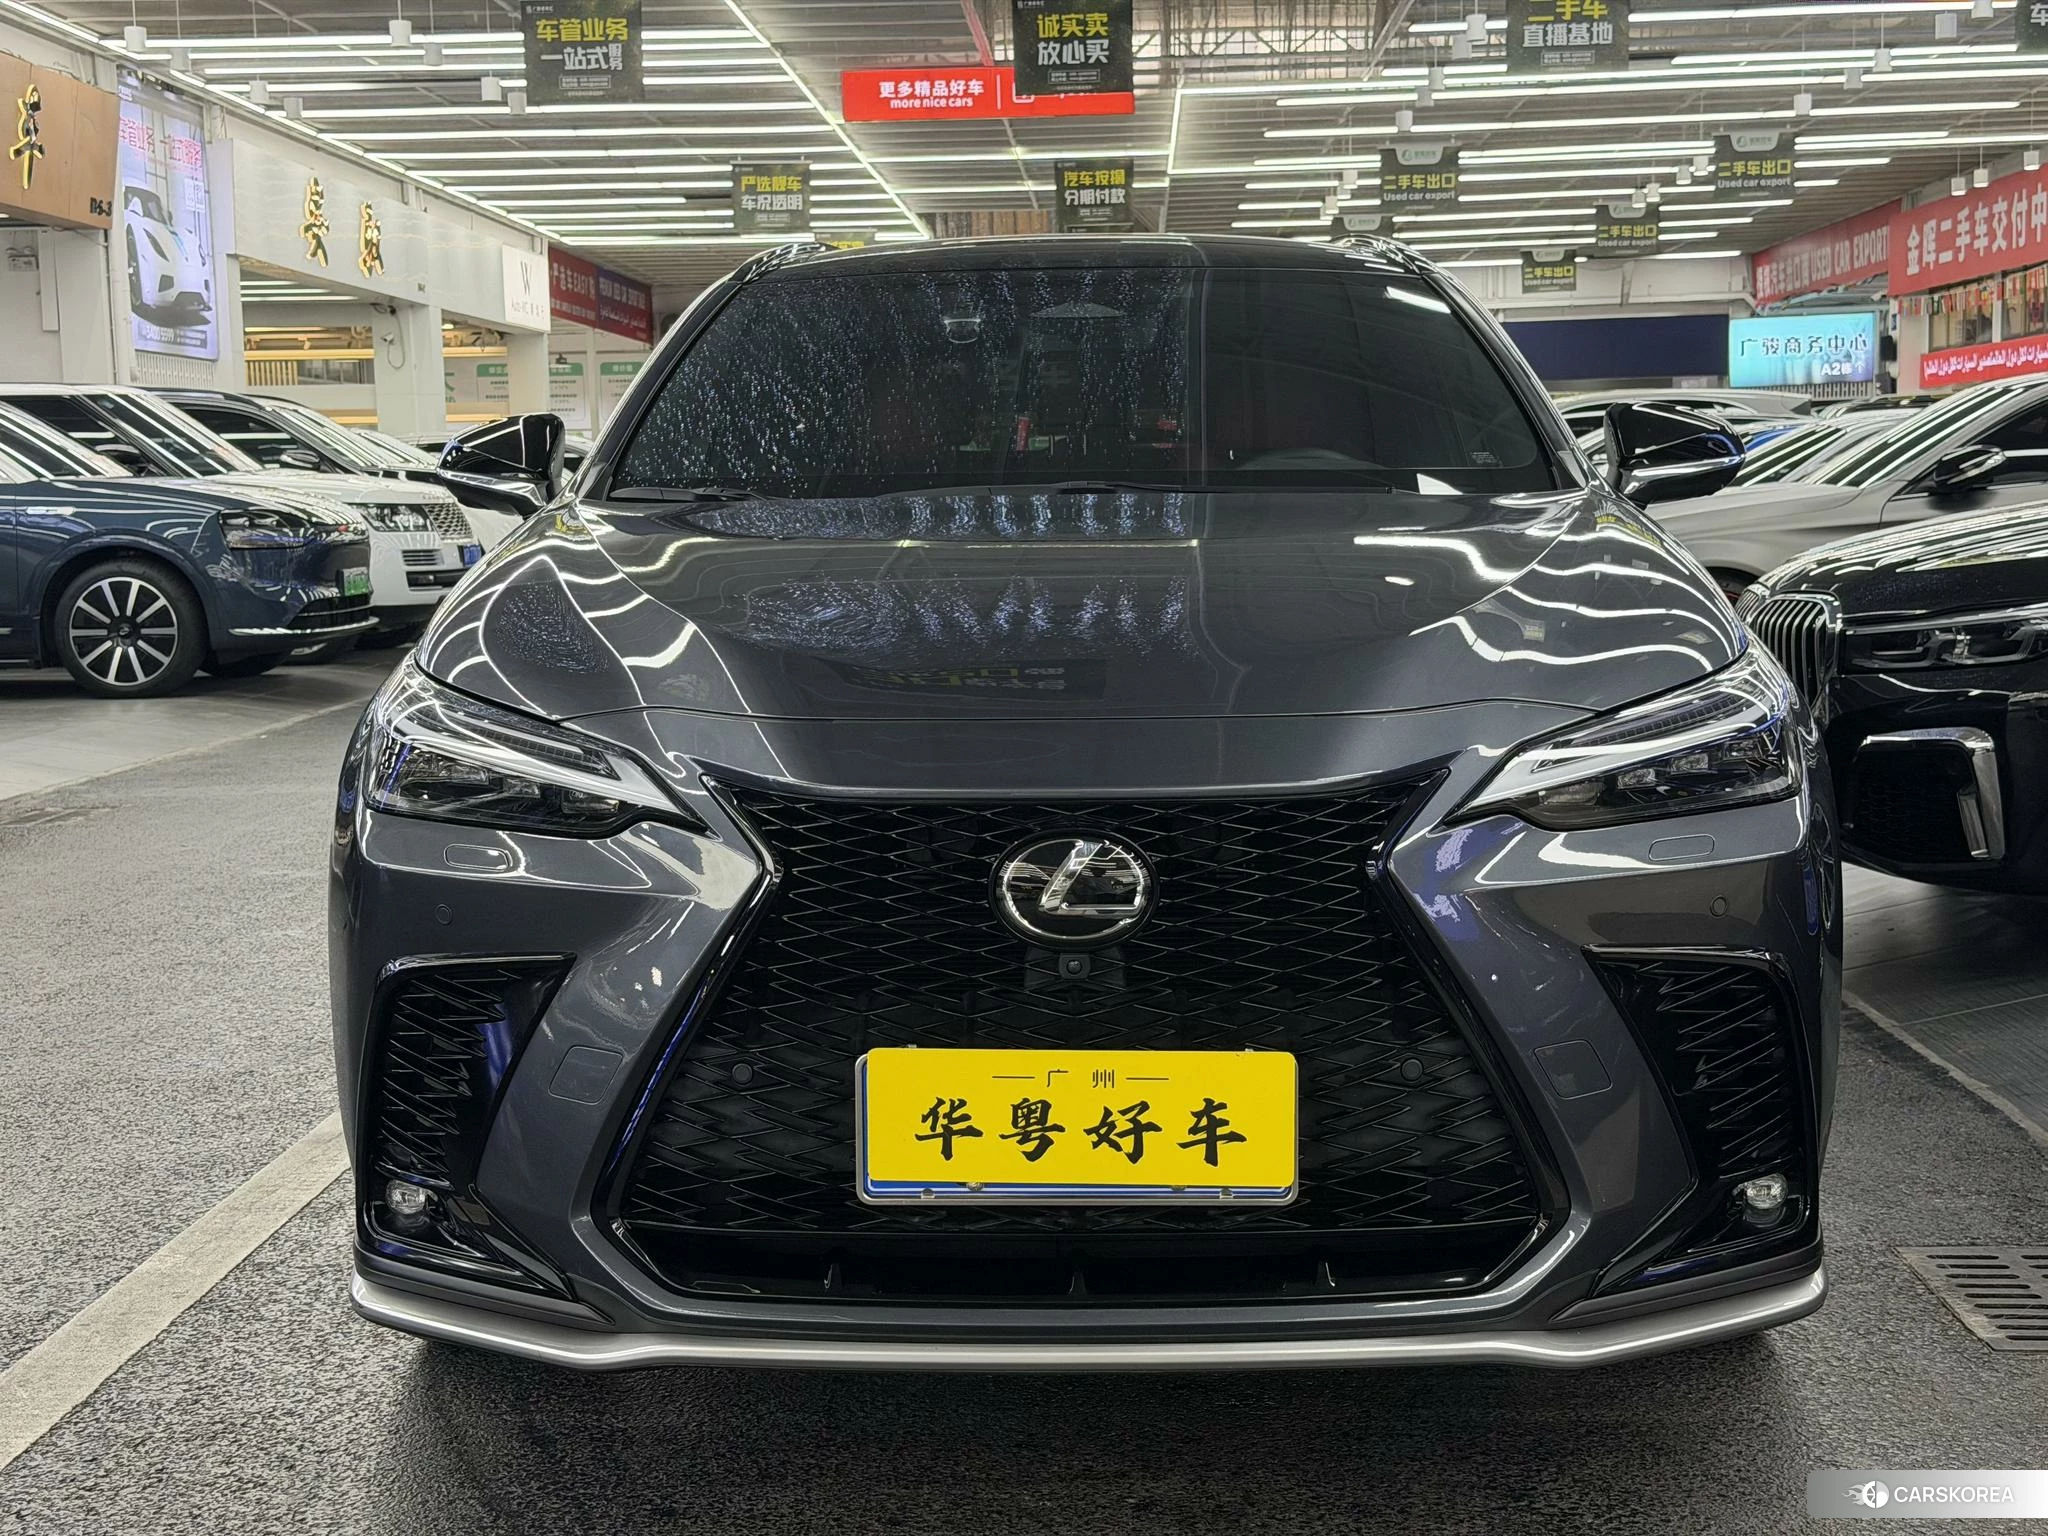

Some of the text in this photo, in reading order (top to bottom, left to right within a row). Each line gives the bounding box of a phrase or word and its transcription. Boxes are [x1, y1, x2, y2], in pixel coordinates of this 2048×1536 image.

[1528, 0, 1608, 20] 二手车
[536, 18, 628, 42] 车管业务
[1036, 13, 1109, 38] 诚实卖
[1522, 21, 1613, 47] 直播基地
[1037, 39, 1109, 66] 放心买
[878, 79, 984, 98] 更多精品好车
[890, 97, 974, 108] more nice cars
[1718, 159, 1791, 177] 二手车出口
[741, 176, 802, 192] 严选靓车
[1064, 169, 1125, 187] 汽车按揭
[1383, 173, 1456, 189] 二手车出口
[1717, 179, 1742, 188] Used
[1759, 177, 1791, 188] export
[741, 195, 803, 211] 车况透明
[1064, 188, 1125, 205] 分期付款
[1383, 190, 1455, 201] Used car export
[1598, 224, 1657, 238] 二手车出口
[1906, 182, 2047, 276] 金晖二手车交付中
[1810, 225, 1889, 281] USED CAR EXPORT
[1740, 333, 1868, 356] 广骏商务中心
[1046, 1068, 1115, 1088] 广州
[914, 1096, 1248, 1168] 华粤好车
